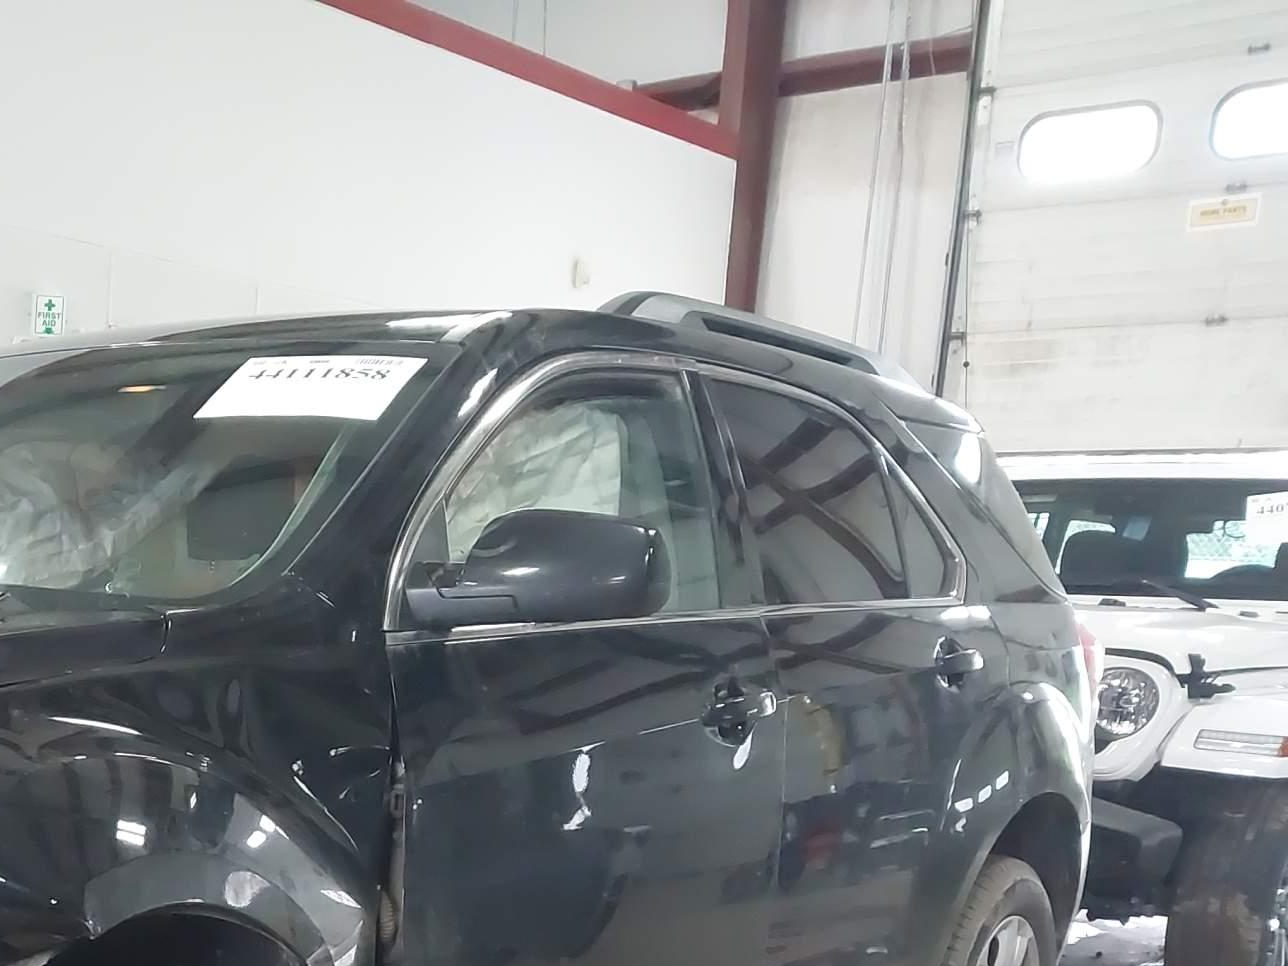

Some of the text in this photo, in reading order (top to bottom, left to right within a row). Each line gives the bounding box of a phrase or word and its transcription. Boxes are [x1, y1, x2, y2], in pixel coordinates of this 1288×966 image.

[37, 312, 61, 320] FIRST
[248, 367, 390, 380] 44111858
[1255, 502, 1288, 514] 440
